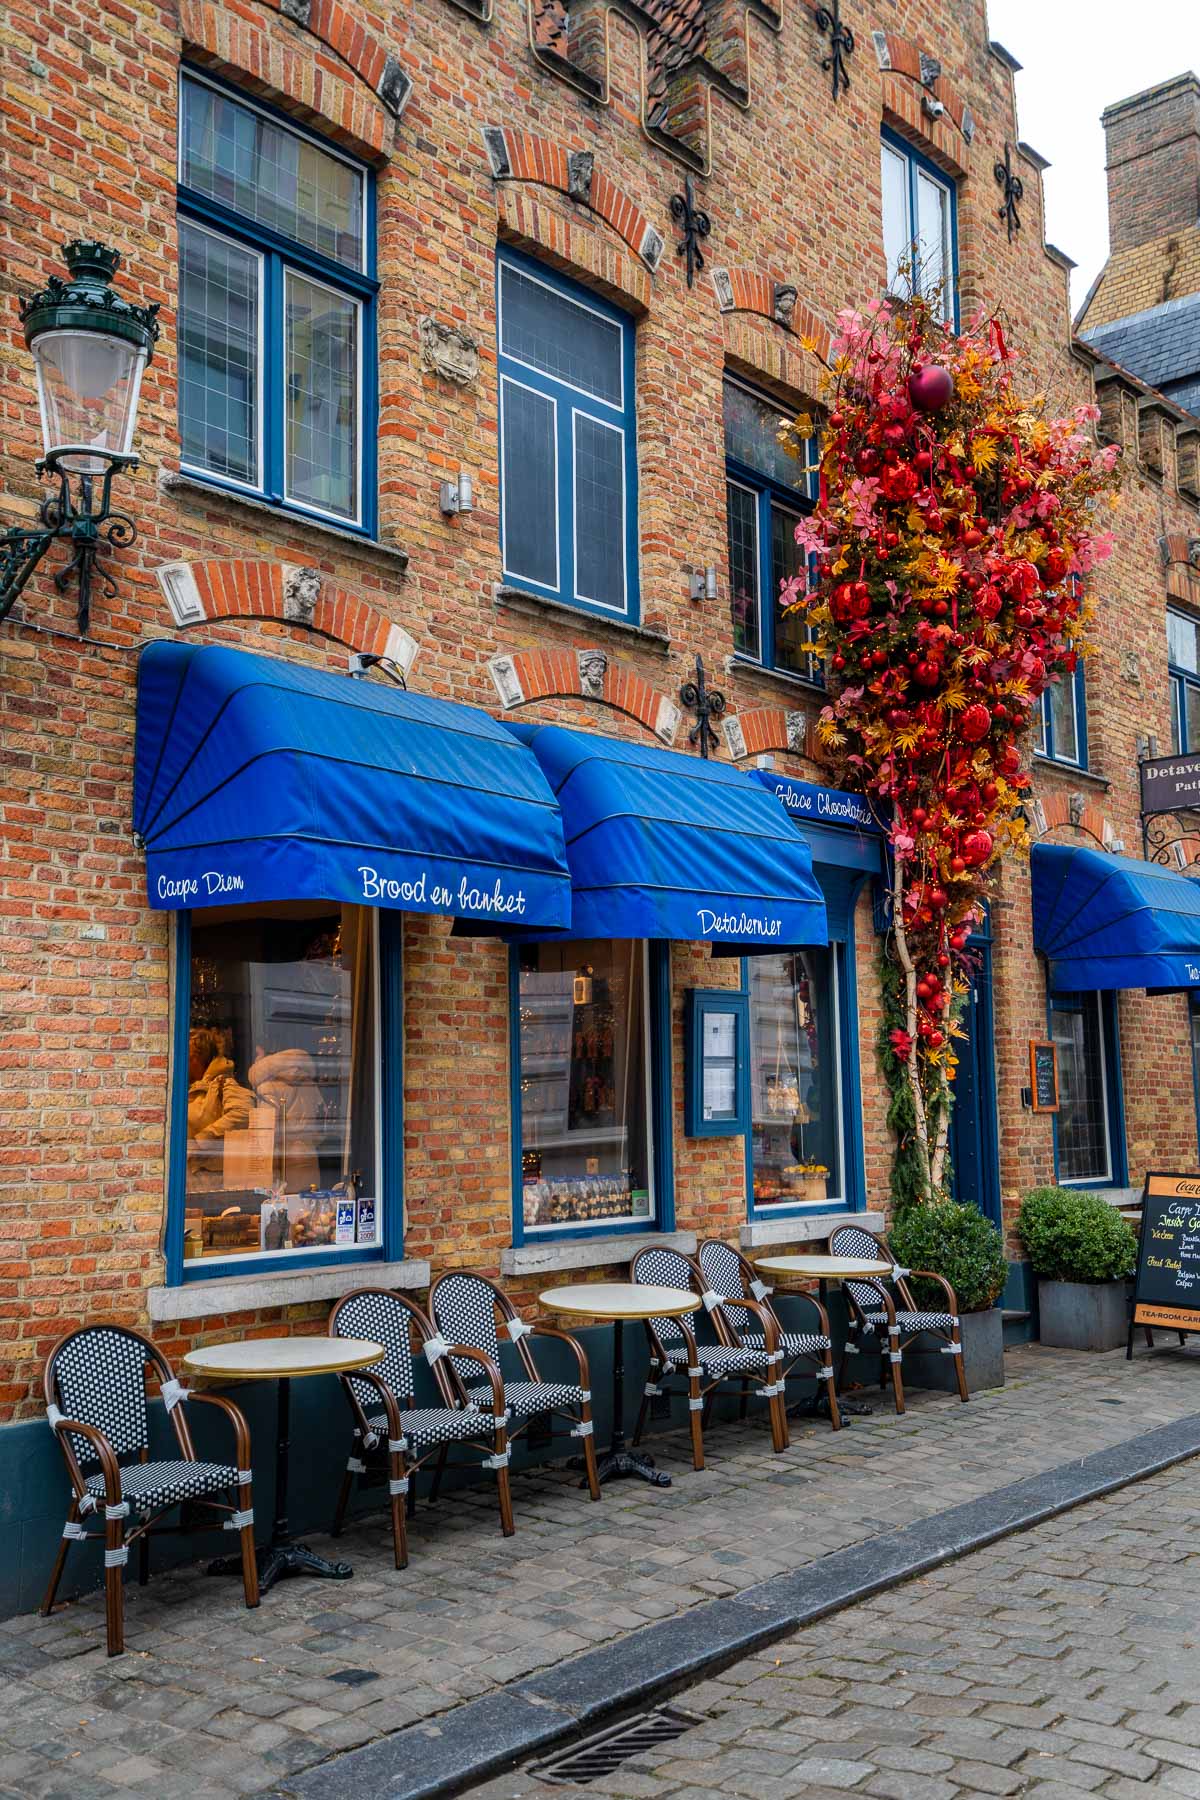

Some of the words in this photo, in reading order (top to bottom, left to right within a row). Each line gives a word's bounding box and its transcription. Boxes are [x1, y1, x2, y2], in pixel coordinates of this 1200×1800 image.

[775, 784, 812, 810] Glace
[157, 874, 199, 903] Carpe
[201, 871, 245, 895] Diem
[357, 866, 427, 903] Brood
[430, 885, 454, 908] en
[457, 876, 526, 915] banket
[697, 909, 782, 937] Detavernier
